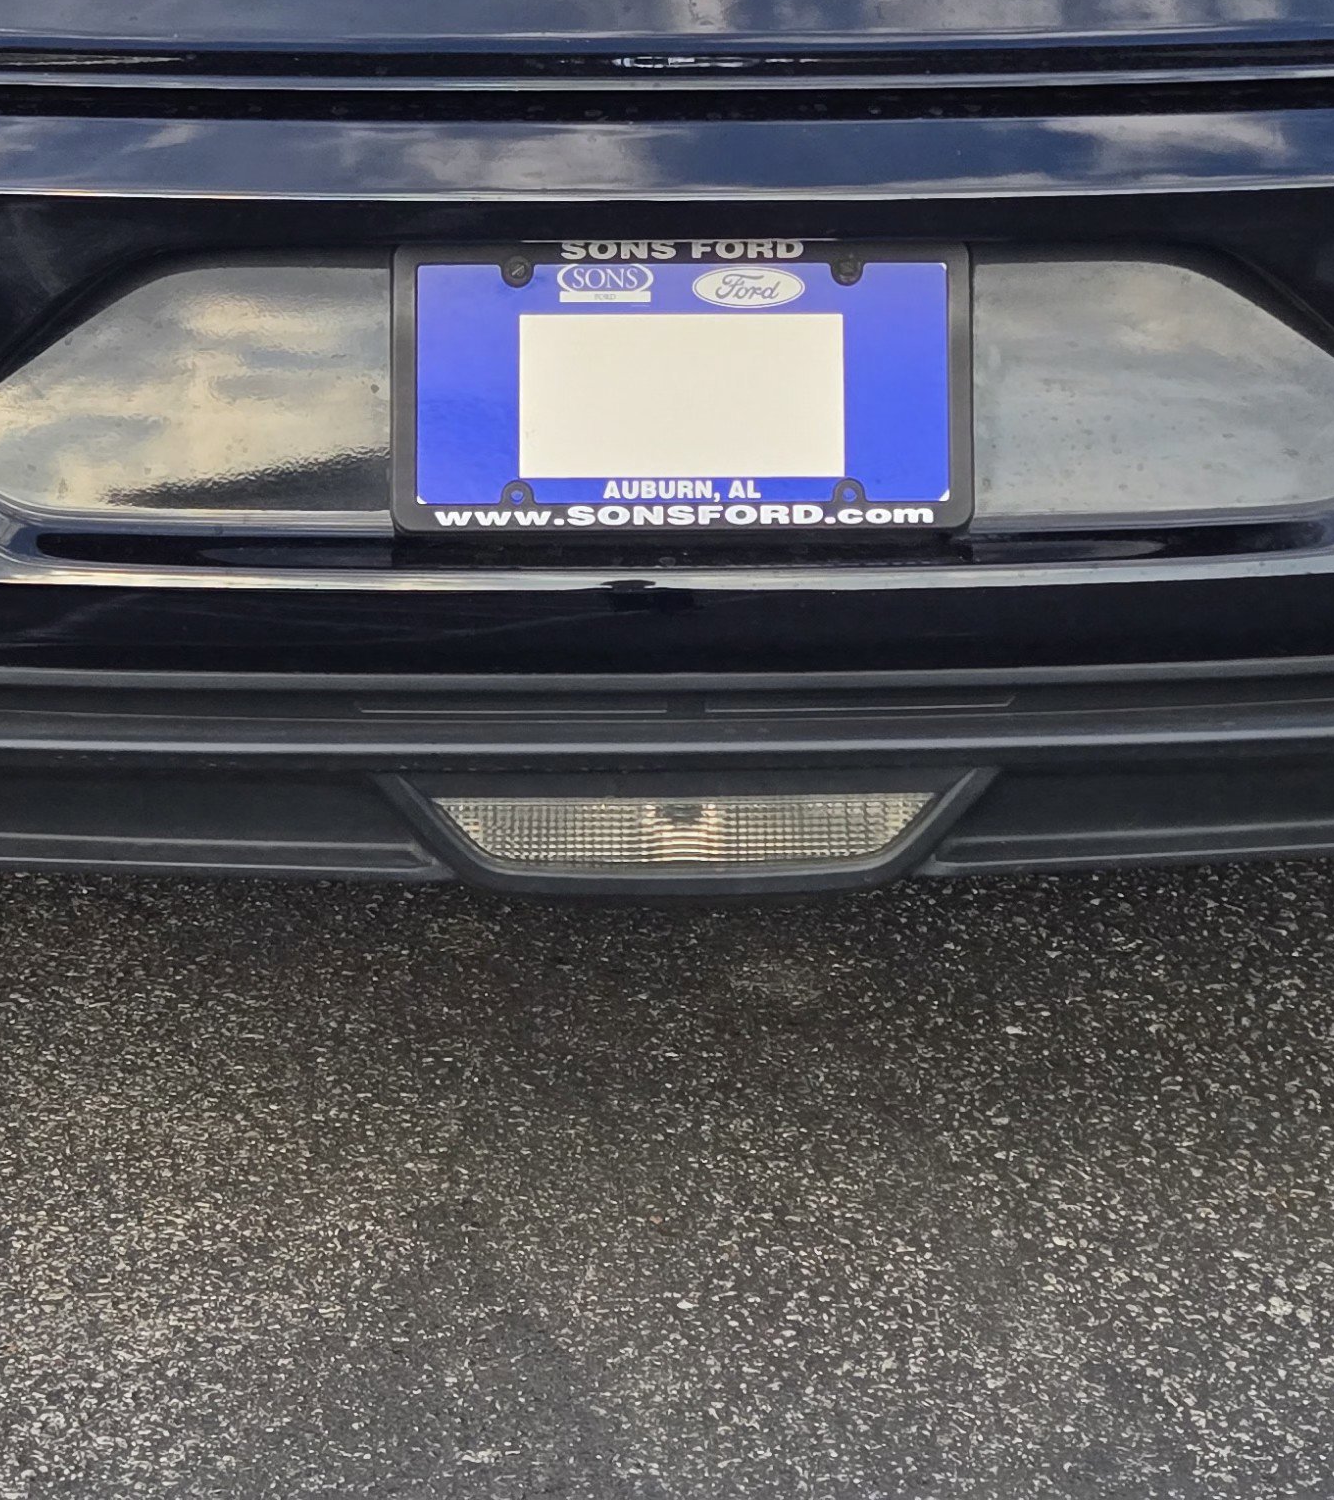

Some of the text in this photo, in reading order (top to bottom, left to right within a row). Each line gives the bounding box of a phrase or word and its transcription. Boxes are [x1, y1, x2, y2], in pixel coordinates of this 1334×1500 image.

[560, 239, 804, 260] SONS FORD
[572, 267, 639, 290] SONS
[714, 272, 781, 300] Ford
[602, 479, 762, 503] AUBURN, AL
[434, 504, 935, 527] www.SONSFORD.com
